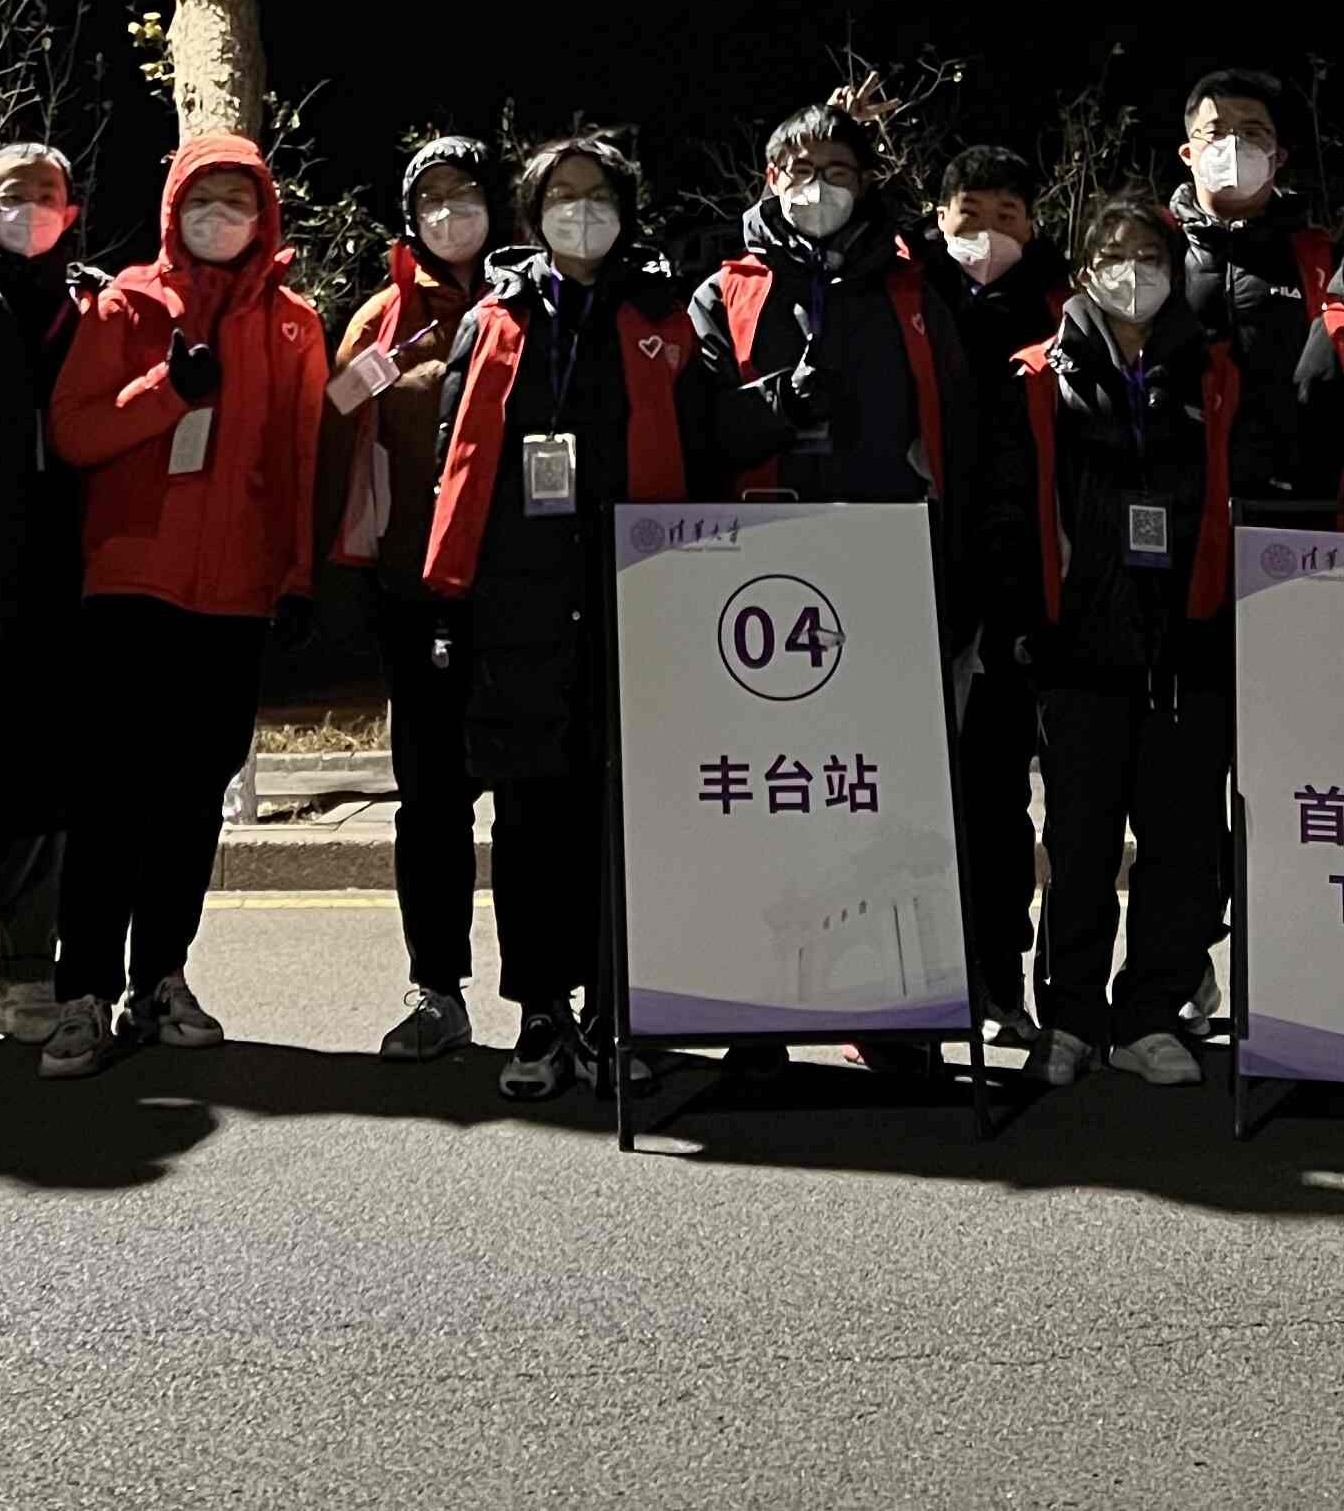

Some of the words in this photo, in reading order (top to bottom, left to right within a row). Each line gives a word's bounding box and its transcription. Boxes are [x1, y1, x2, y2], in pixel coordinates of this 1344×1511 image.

[733, 605, 826, 670] 04
[698, 753, 880, 815] 丰台站
